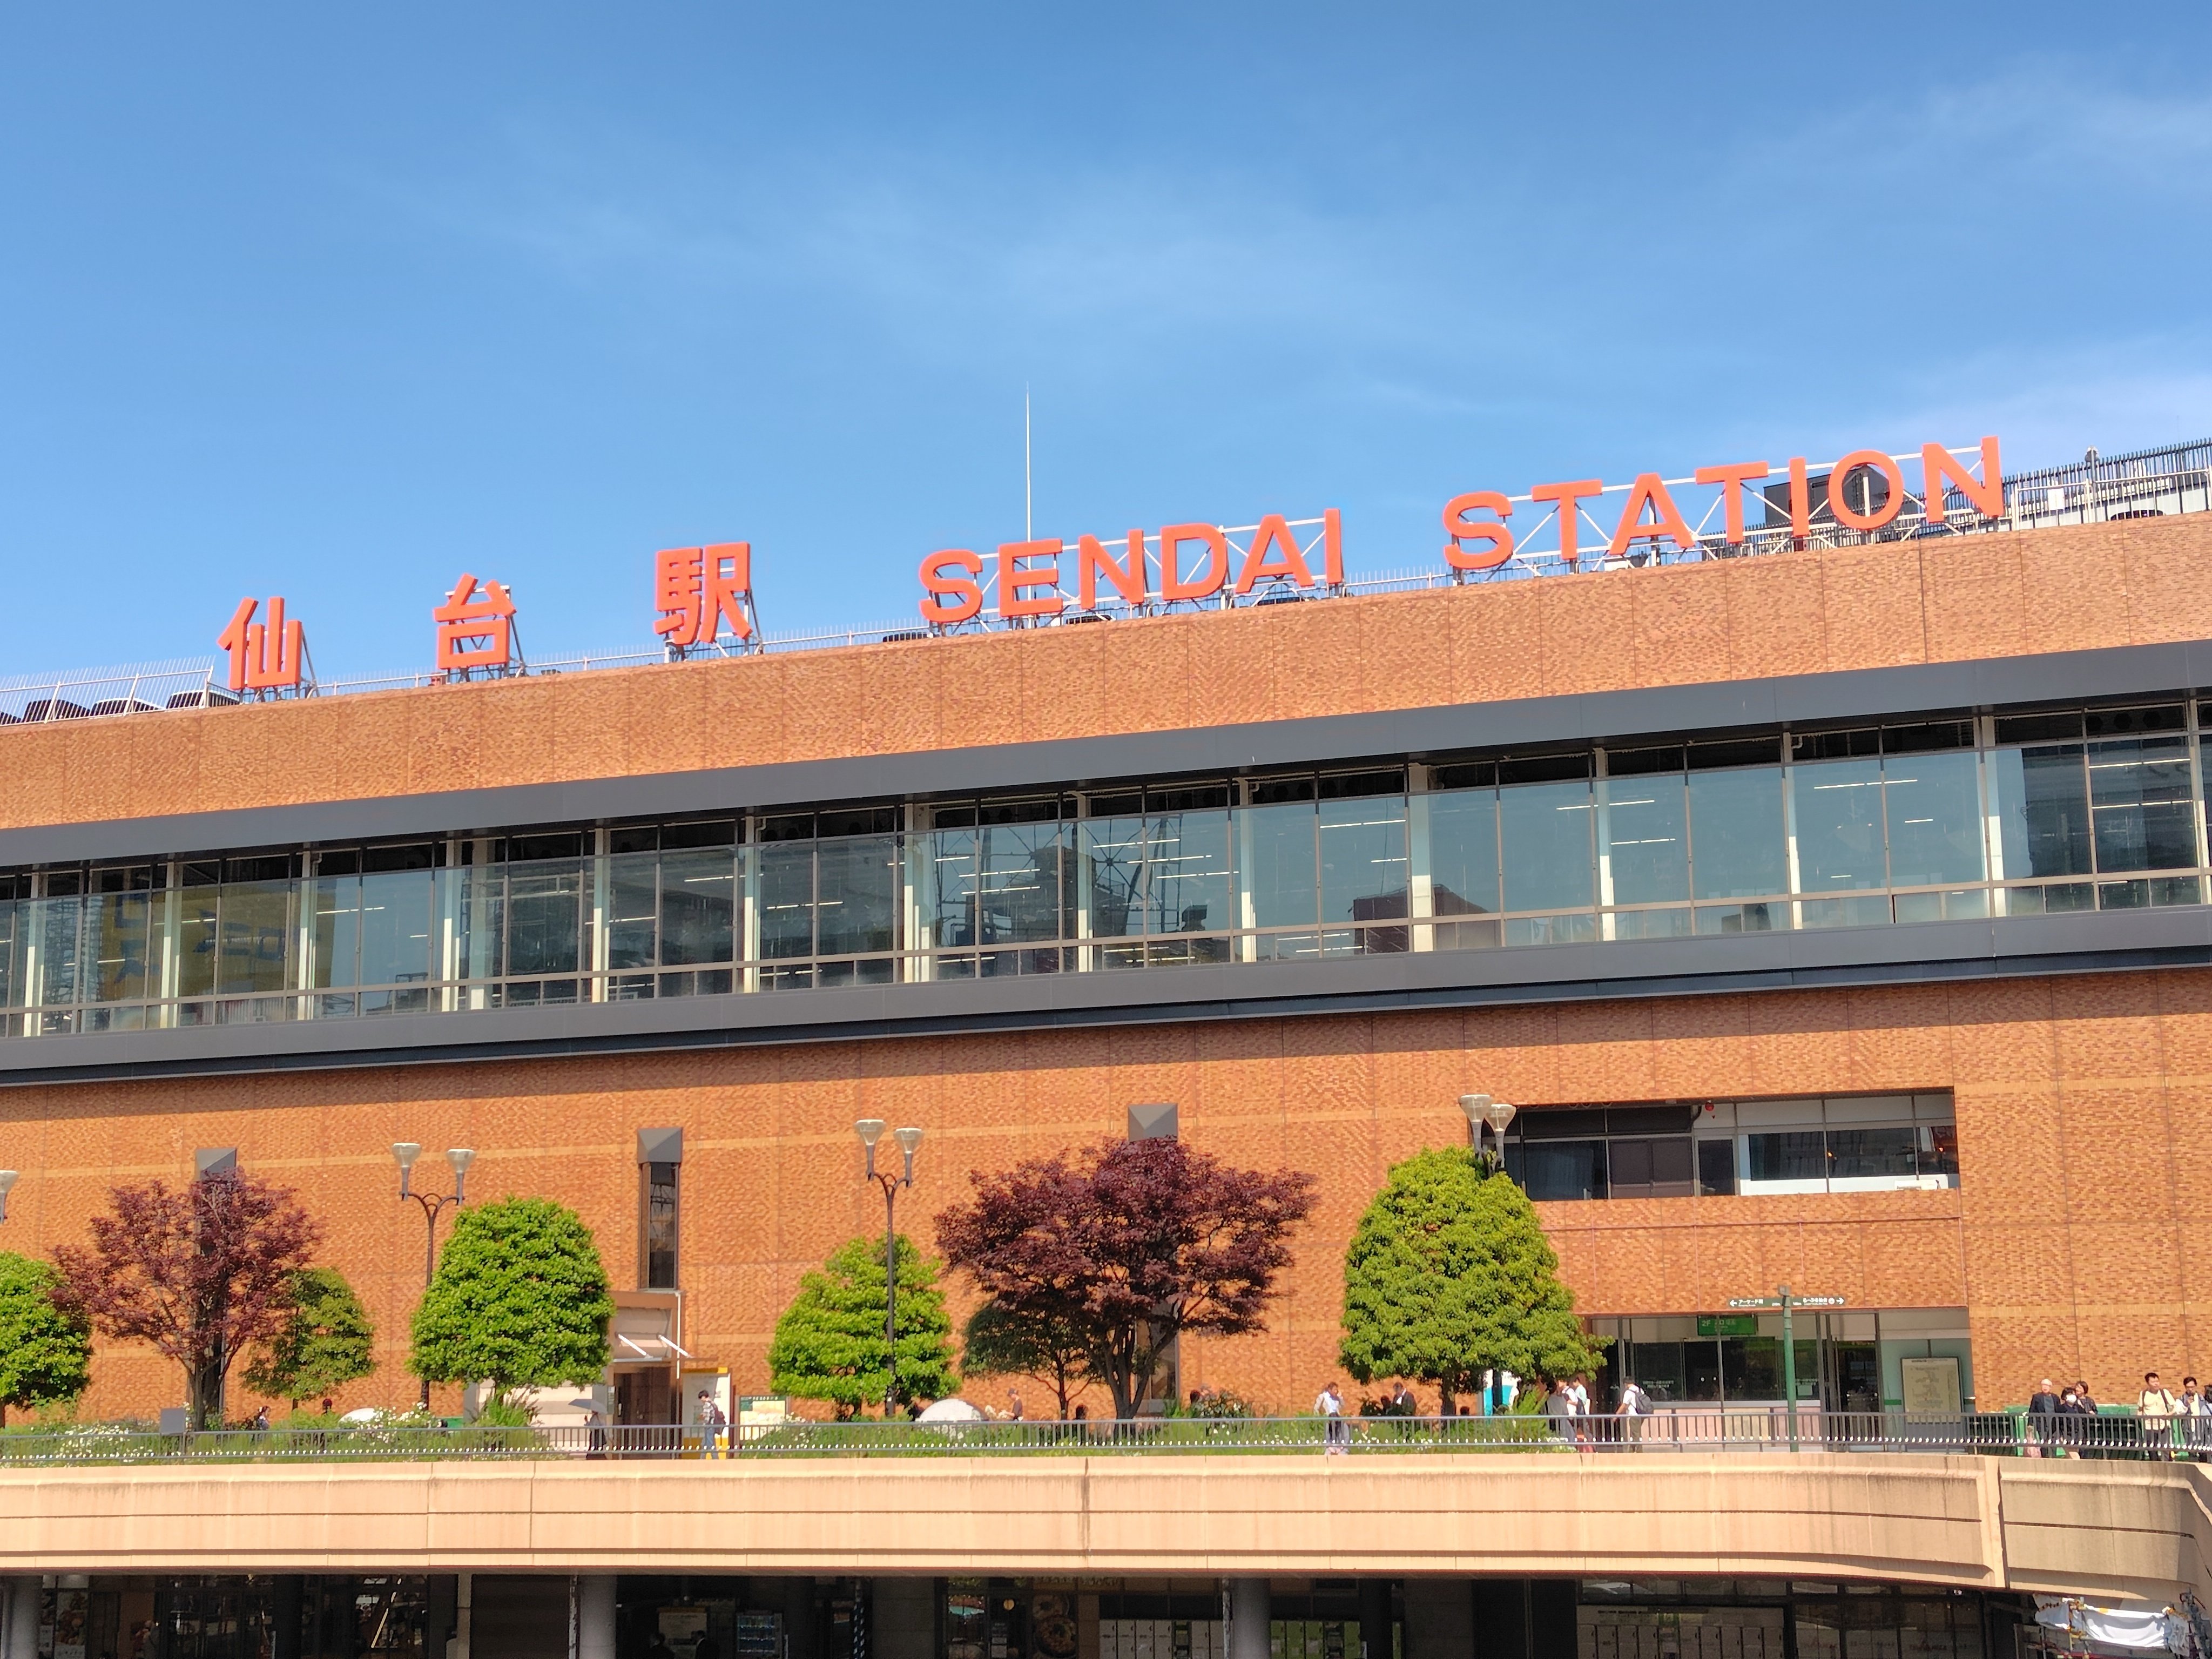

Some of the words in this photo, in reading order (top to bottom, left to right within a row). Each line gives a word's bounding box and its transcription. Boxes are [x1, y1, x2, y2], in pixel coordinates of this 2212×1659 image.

[218, 542, 753, 690] 仙台駅
[919, 508, 1342, 623] SENDAI
[1442, 436, 2005, 569] STATION
